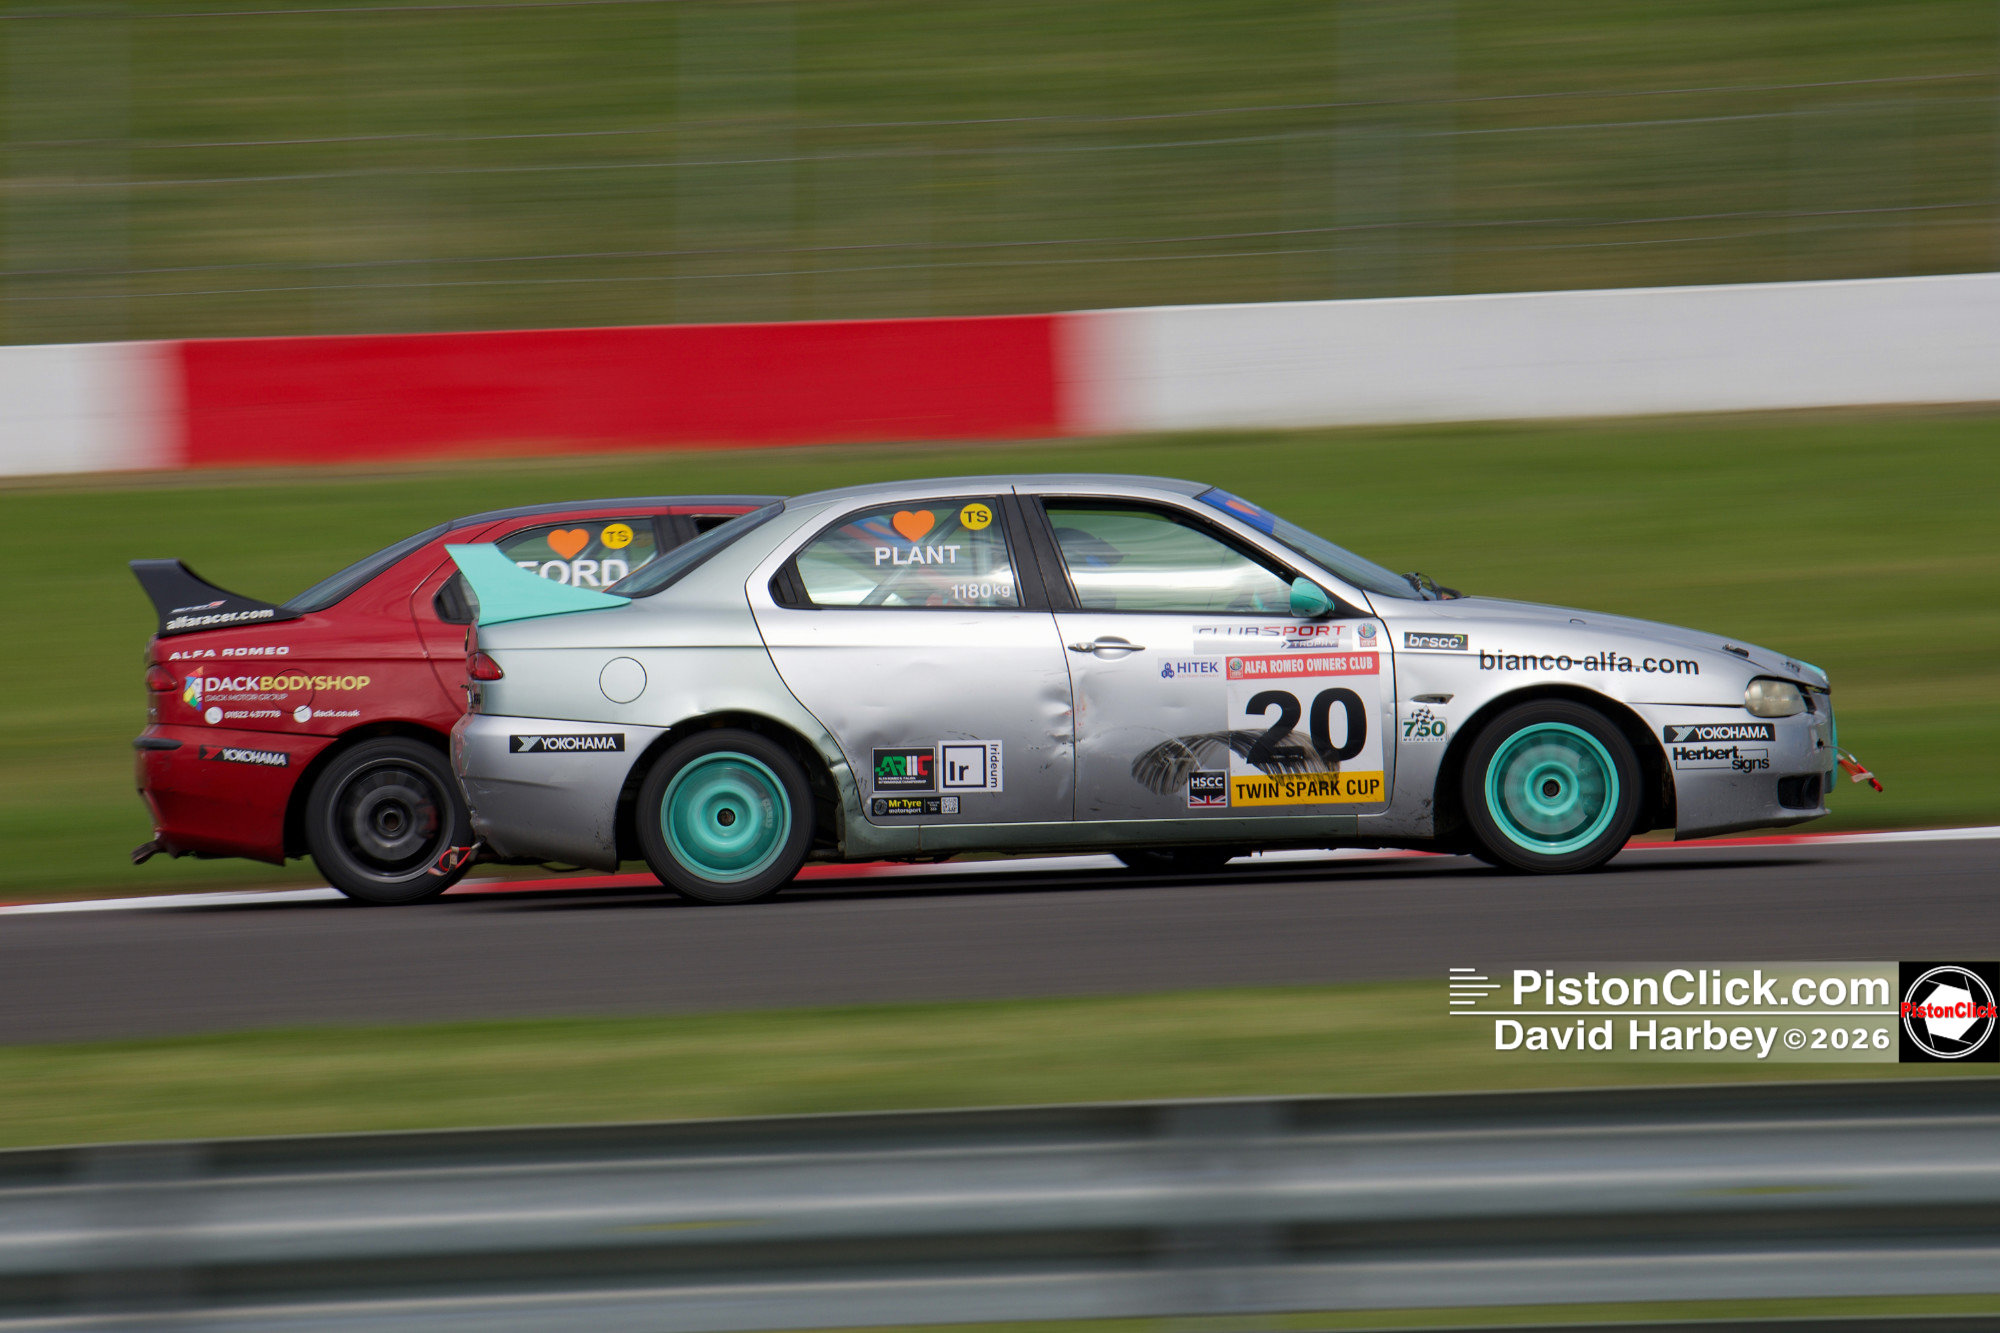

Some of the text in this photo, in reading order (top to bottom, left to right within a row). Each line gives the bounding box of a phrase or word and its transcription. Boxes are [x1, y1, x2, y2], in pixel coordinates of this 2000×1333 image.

[963, 510, 989, 523] TS
[606, 530, 629, 543] TS
[874, 545, 961, 566] PLANT
[951, 583, 1011, 599] 1180kg
[166, 609, 275, 631] alfaracer.com
[1408, 633, 1459, 648] brscc
[169, 646, 290, 661] ALFA ROMEO
[1177, 662, 1219, 673] HITEK
[1244, 656, 1373, 674] ALFA ROMEO OWNERS CLUB
[1479, 649, 1700, 675] bianco-alfa.com
[1245, 687, 1368, 764] 20
[1403, 721, 1446, 737] 750
[1695, 726, 1769, 739] YOKOHAMA
[540, 737, 617, 750] YOKOHAMA
[222, 748, 287, 766] YOKOHAMA
[1672, 745, 1739, 761] Herbert
[950, 761, 969, 781] Ir
[990, 743, 1000, 788] Irideum
[1731, 756, 1770, 774] signs
[1191, 776, 1223, 787] HSCC
[1236, 779, 1380, 800] TWIN SPARK CUP
[888, 799, 901, 808] Mr
[902, 799, 922, 809] Tyre
